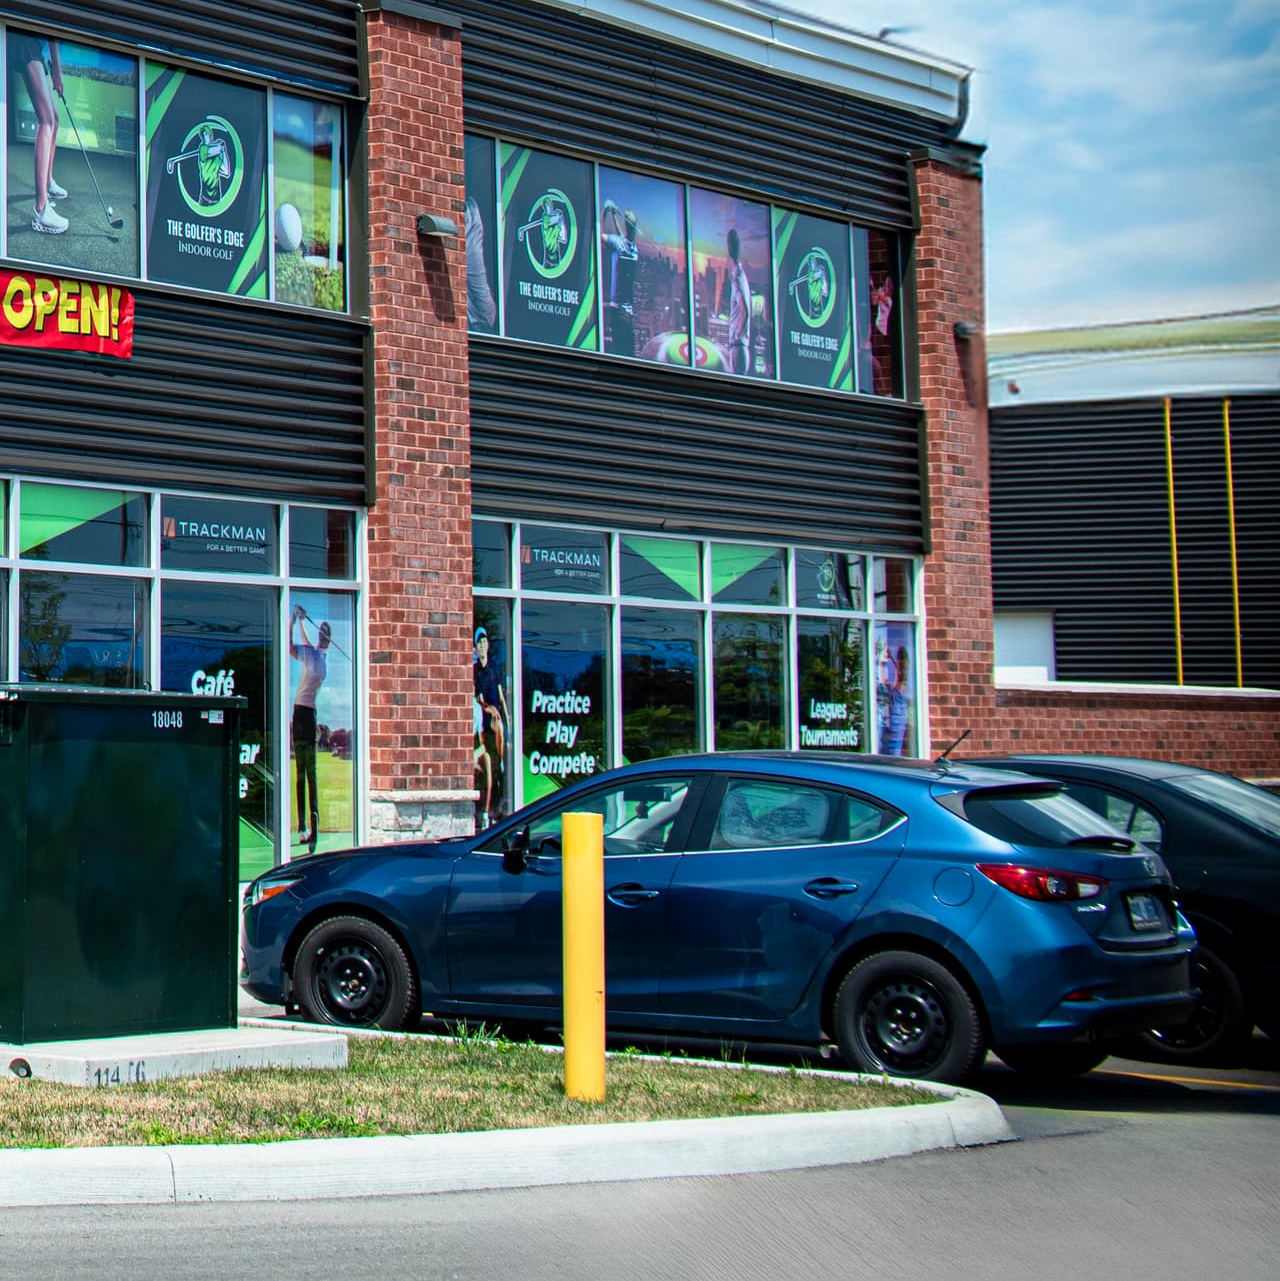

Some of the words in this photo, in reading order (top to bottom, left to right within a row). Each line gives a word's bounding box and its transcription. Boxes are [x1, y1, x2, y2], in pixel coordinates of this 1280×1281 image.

[167, 219, 183, 237] THE
[185, 223, 222, 244] GOLFER'S
[224, 229, 245, 248] EDGE
[178, 240, 212, 257] INDOOR
[213, 248, 234, 260] GOLF
[519, 281, 532, 296] THE
[533, 284, 562, 302] GOLFER'S
[563, 289, 579, 305] EDGE
[2, 276, 121, 342] OPEN!
[528, 299, 554, 313] INDOOR
[555, 305, 570, 316] GOLF
[179, 521, 266, 541] TRACKMAN
[226, 545, 248, 553] BETTER
[533, 549, 600, 566] TRACKMAN
[192, 669, 235, 696] Café
[531, 690, 591, 714] Practice
[810, 698, 848, 723] Leagues
[152, 710, 183, 728] 18048
[546, 720, 579, 748] Play
[800, 725, 858, 746] Tournaments
[239, 744, 260, 764] ar
[529, 750, 595, 778] Compete
[94, 1065, 120, 1086] 114
